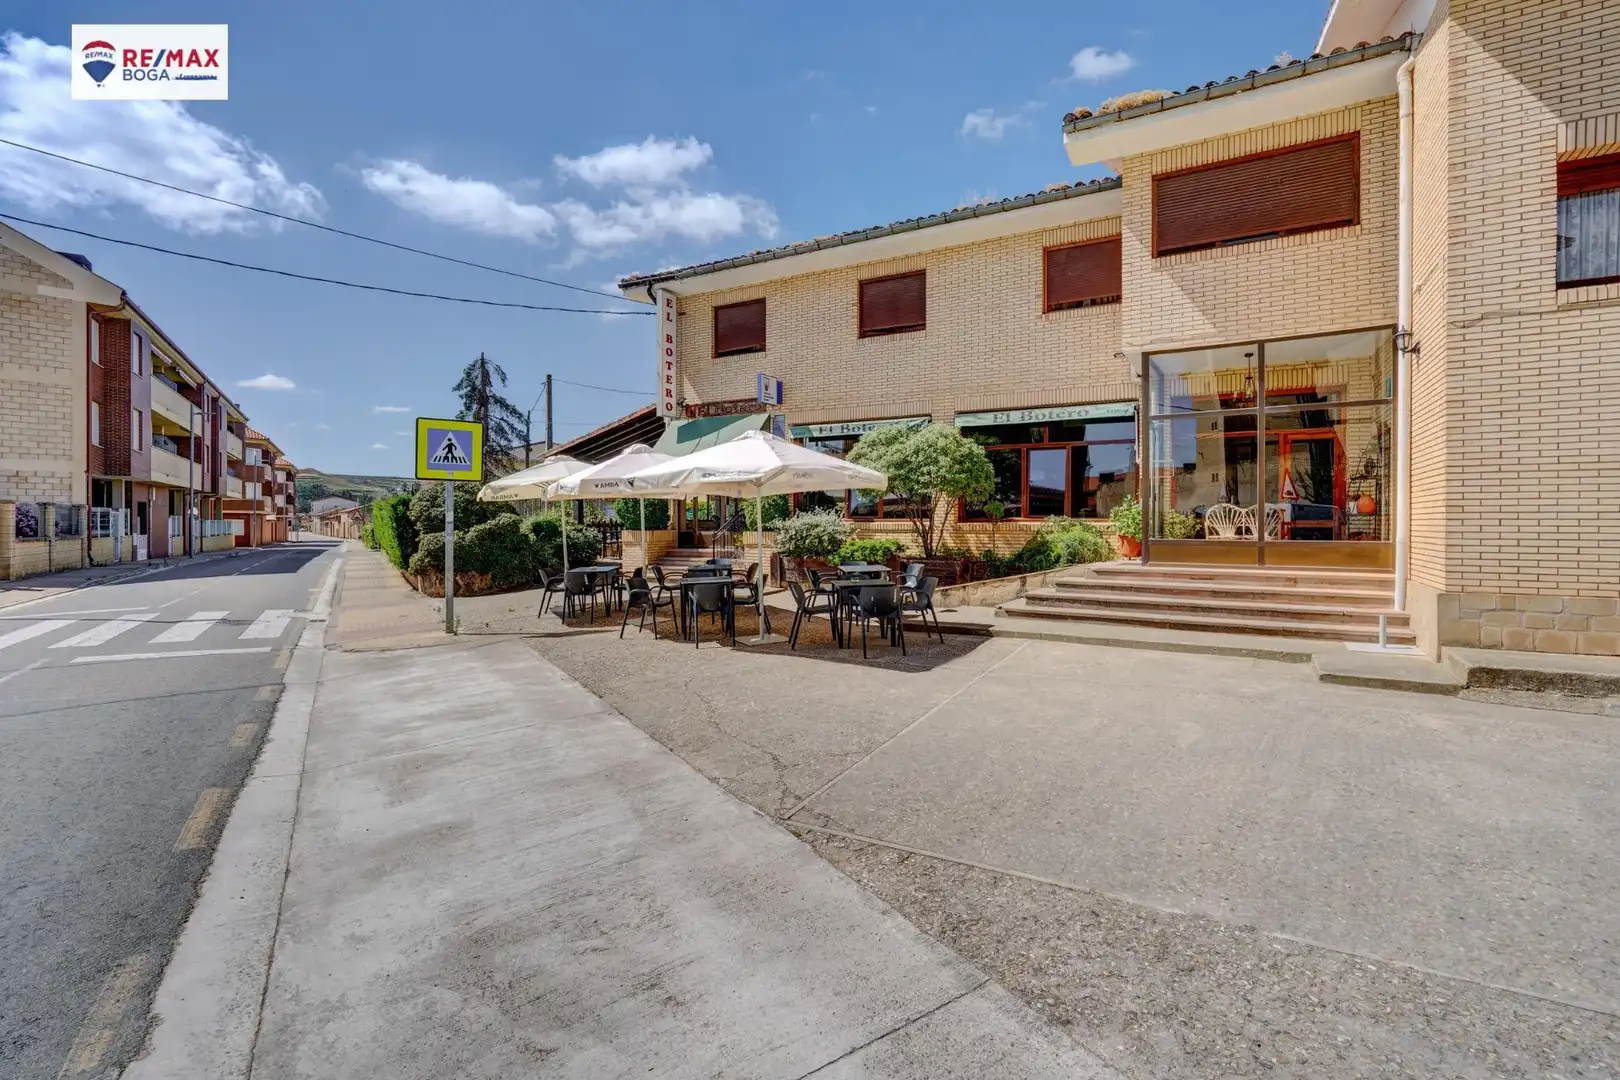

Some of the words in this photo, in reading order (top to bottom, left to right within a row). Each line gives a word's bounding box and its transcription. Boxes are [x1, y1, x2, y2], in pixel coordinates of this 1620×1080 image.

[666, 298, 673, 323] EL
[993, 411, 1011, 424] El
[1021, 405, 1090, 422] Botero
[819, 425, 833, 435] El
[840, 423, 877, 434] Bote
